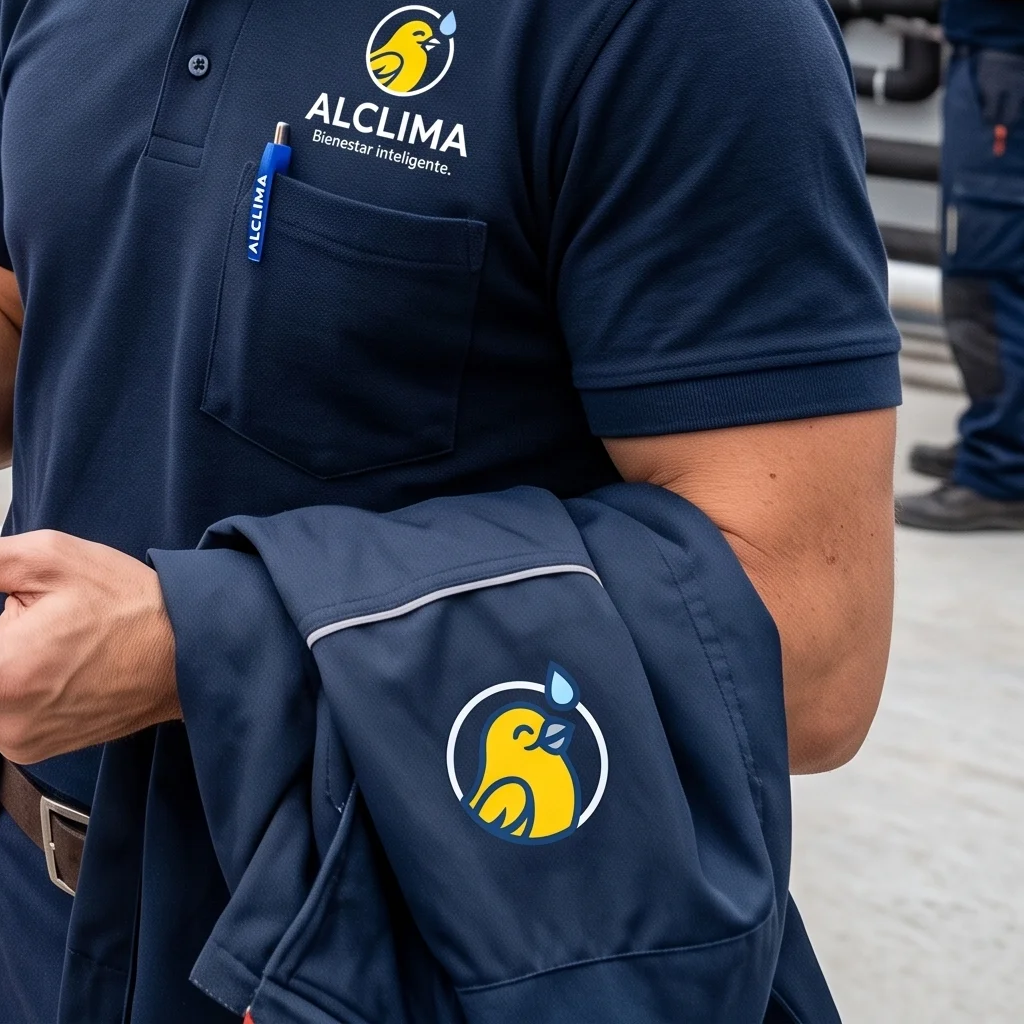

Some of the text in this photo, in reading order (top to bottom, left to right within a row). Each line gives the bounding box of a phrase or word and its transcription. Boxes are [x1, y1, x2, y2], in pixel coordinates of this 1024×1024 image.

[304, 92, 468, 158] ALCLIMA
[312, 129, 452, 176] Bienestar inteligente.
[248, 174, 268, 255] ALCLIMA
